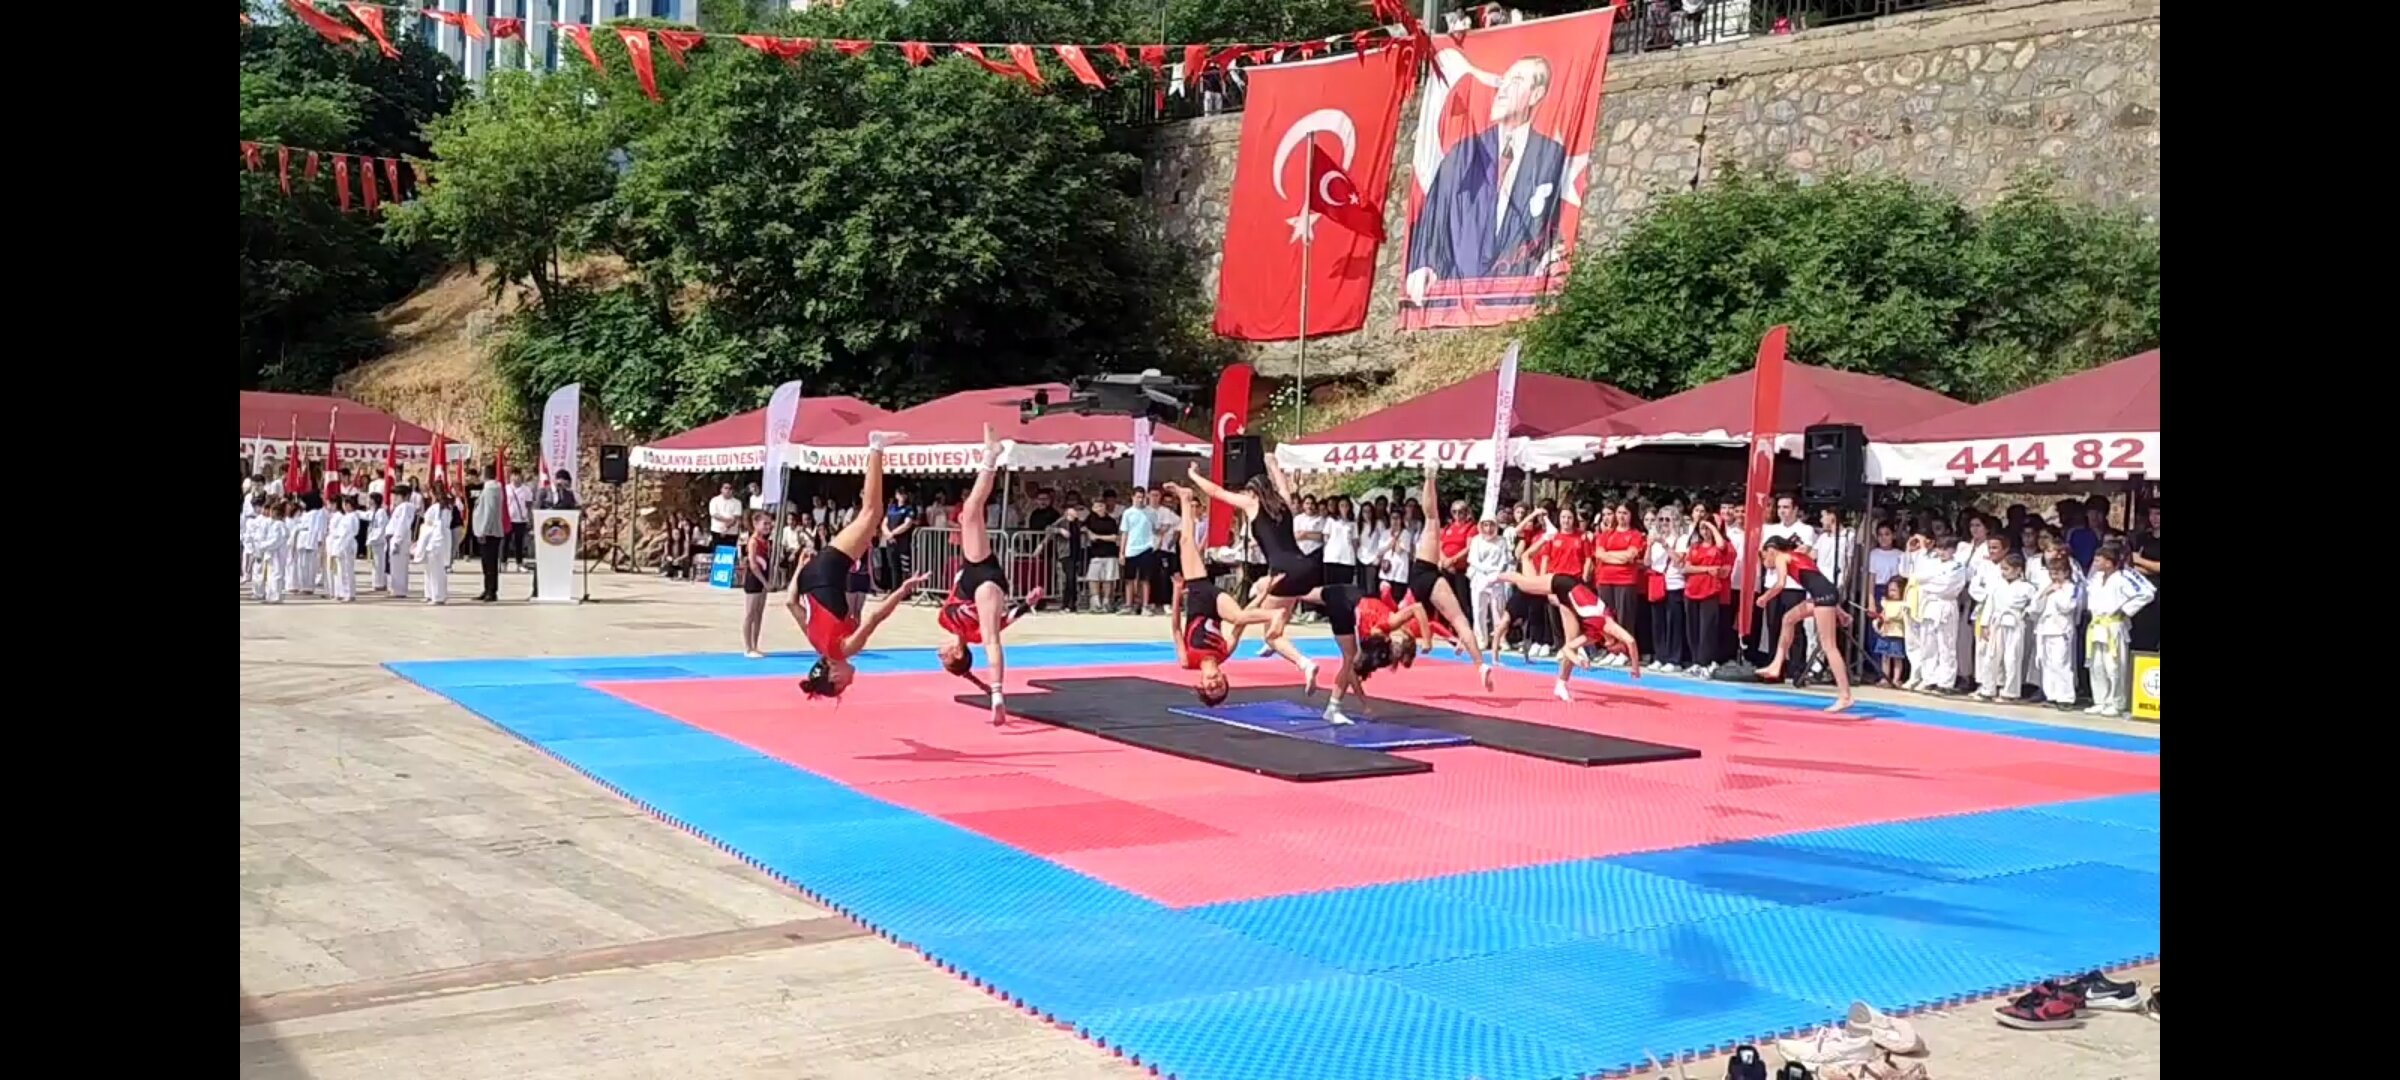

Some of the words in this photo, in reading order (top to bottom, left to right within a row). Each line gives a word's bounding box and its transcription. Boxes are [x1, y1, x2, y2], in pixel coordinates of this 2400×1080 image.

[653, 454, 692, 466] ALANYA
[696, 451, 759, 466] BELEDİYESİ
[819, 453, 870, 467] ALANY
[881, 450, 970, 467] BELEDİYESİ
[1066, 441, 1118, 460] 444
[1323, 443, 1379, 465] 444
[1390, 442, 1426, 460] 82
[1438, 441, 1475, 461] 07
[1946, 441, 2050, 474] 444
[2072, 438, 2145, 469] 82
